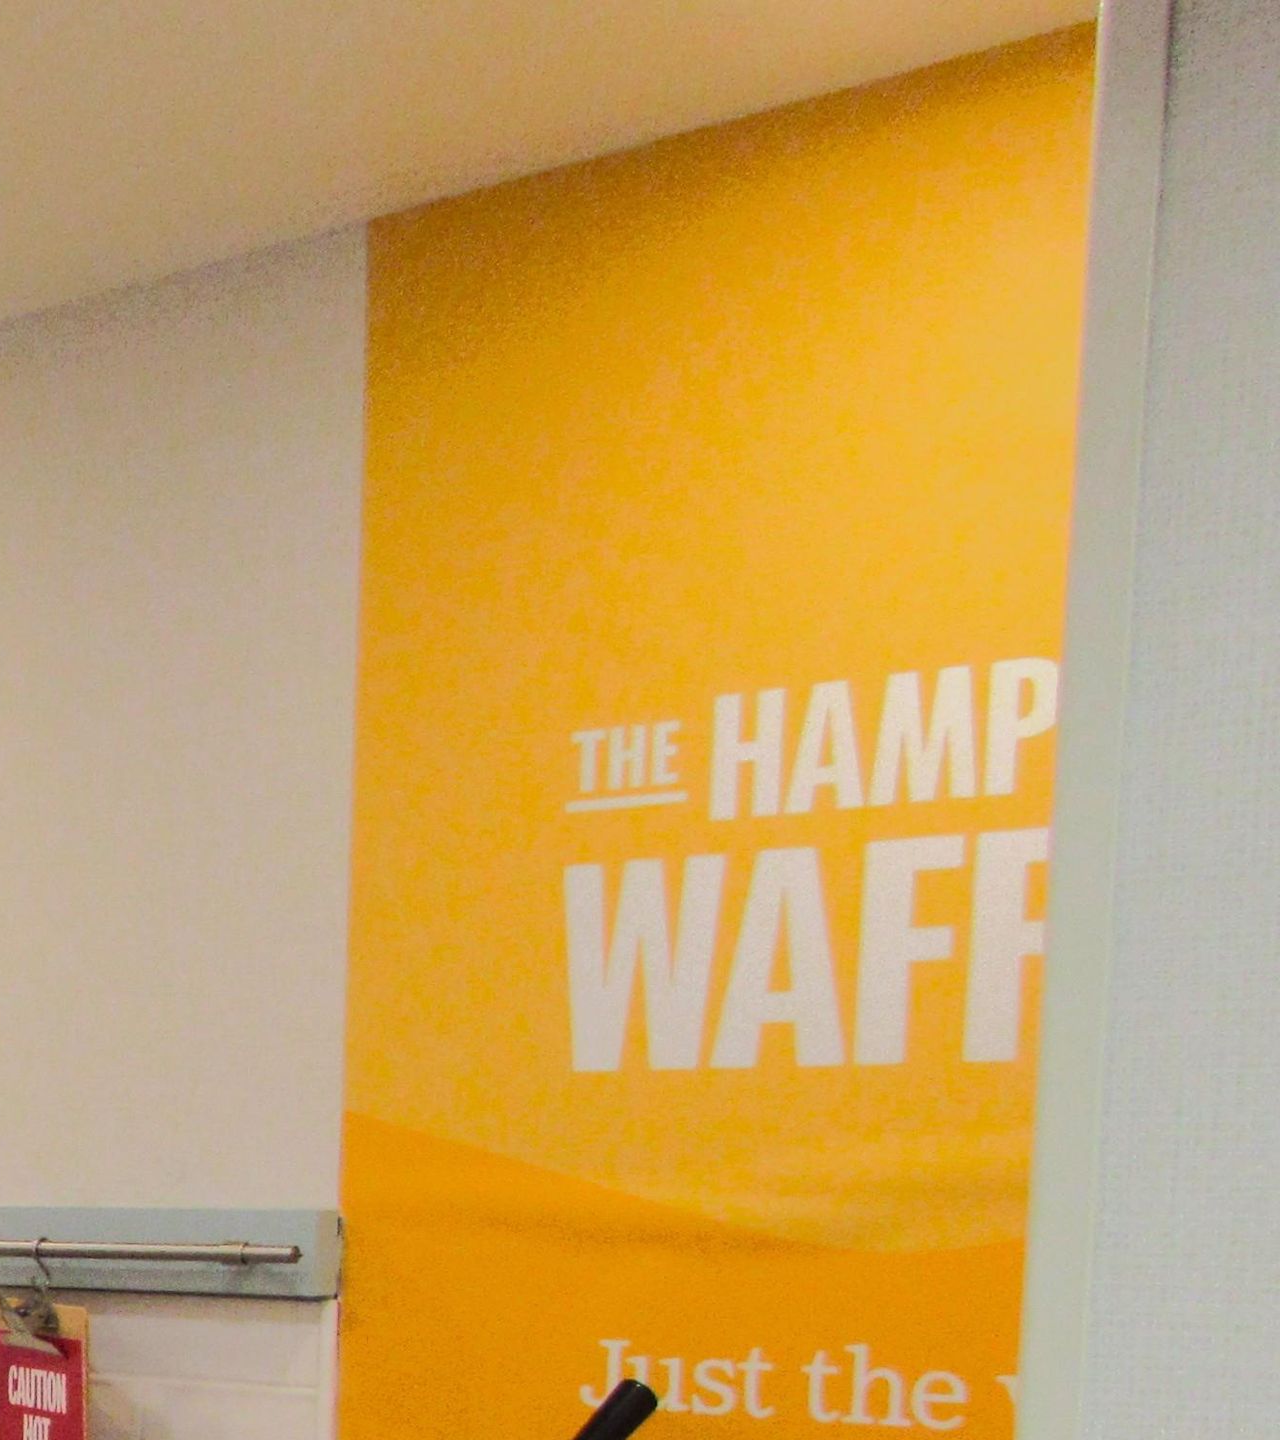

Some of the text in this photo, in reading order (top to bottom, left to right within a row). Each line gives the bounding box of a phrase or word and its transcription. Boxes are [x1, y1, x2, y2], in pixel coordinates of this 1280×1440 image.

[571, 656, 1060, 822] THE HAMP
[563, 826, 1052, 1073] WAFF
[7, 1364, 68, 1416] CAUTION
[579, 1338, 969, 1431] Just the
